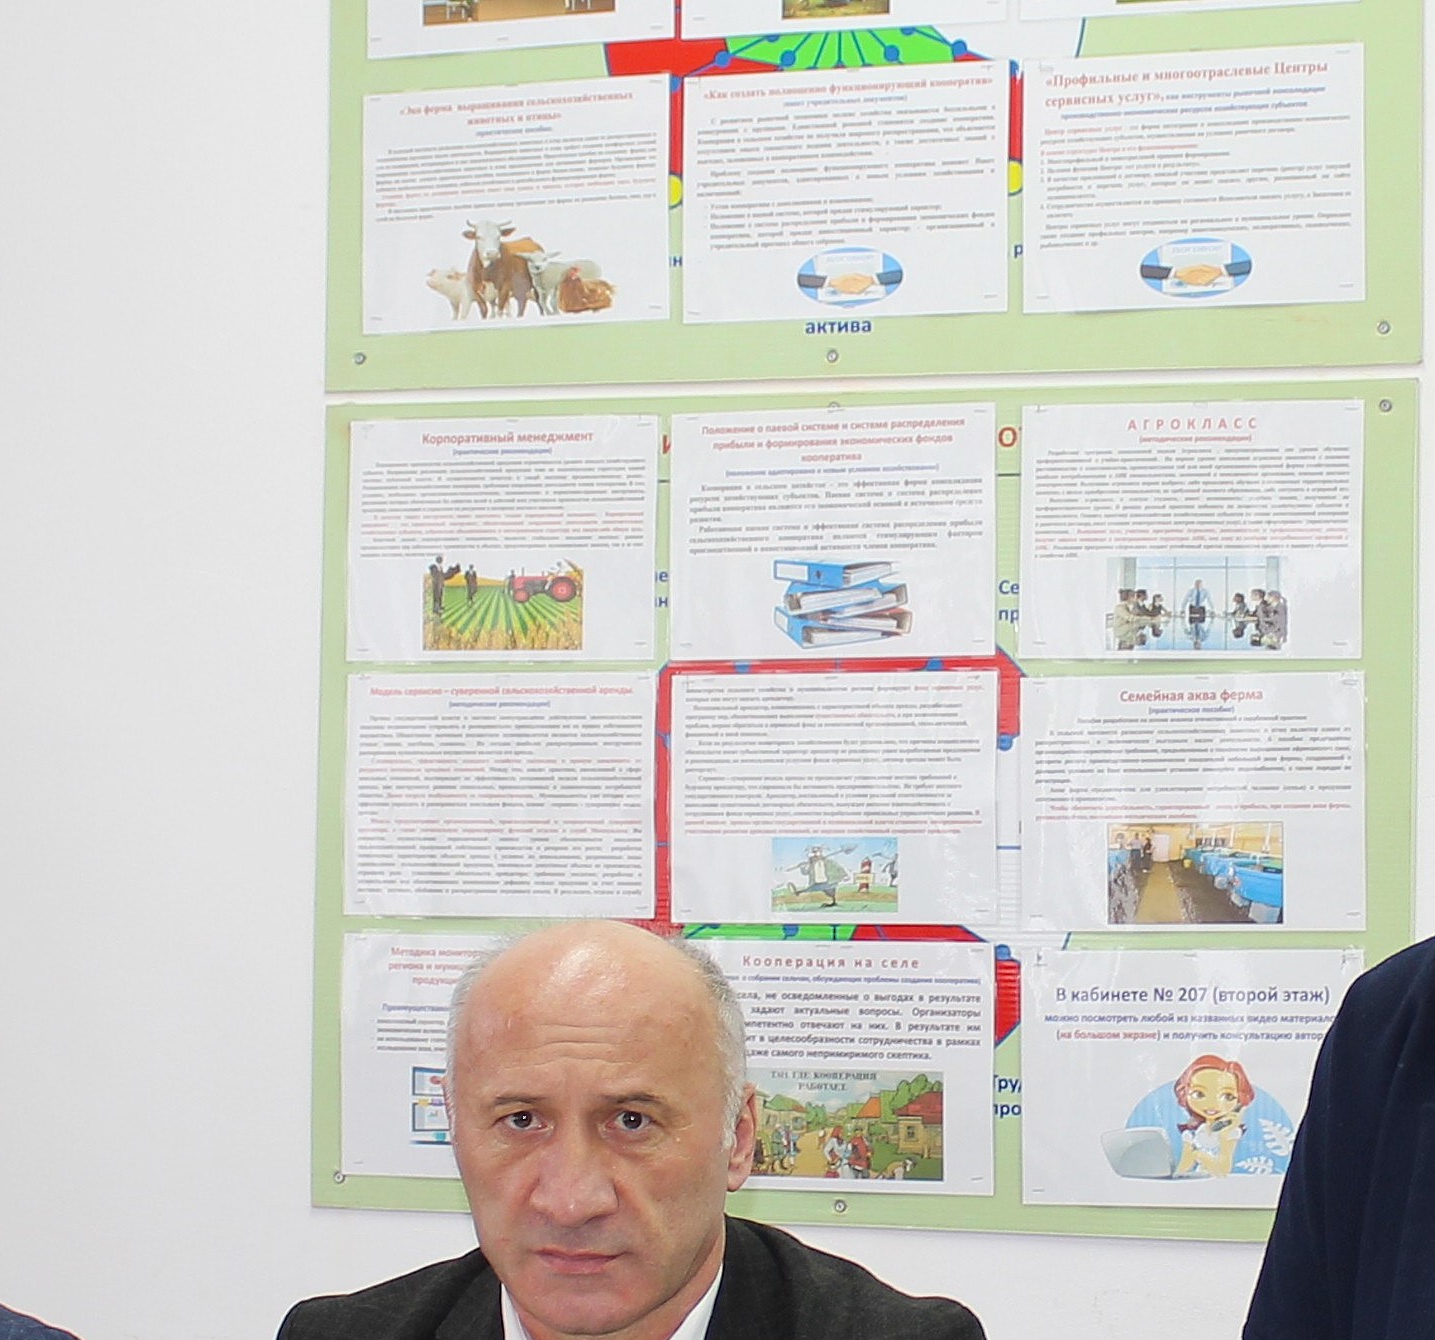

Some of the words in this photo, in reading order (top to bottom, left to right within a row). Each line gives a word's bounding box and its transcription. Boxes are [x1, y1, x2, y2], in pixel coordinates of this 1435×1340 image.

[1046, 71, 1138, 88] «Профильные
[1155, 64, 1270, 82] многоотраслевые
[1274, 61, 1328, 75] Центры
[1045, 94, 1113, 108] сервисных
[805, 320, 871, 334] актива
[702, 425, 755, 436] Положение
[766, 422, 798, 432] паевой
[801, 421, 839, 431] системе
[850, 420, 888, 429] системе
[891, 418, 965, 430] распределения
[422, 432, 514, 445] Корпоративный
[517, 431, 593, 443] менеджмент
[801, 453, 862, 462] кооператива
[1120, 690, 1183, 702] Семейная
[1187, 692, 1216, 700] аква
[1220, 689, 1263, 703] ферма
[743, 955, 845, 969] Кооперация
[854, 958, 872, 968] на
[881, 959, 919, 968] селе
[781, 993, 858, 1001] осведомленные
[875, 994, 914, 1002] выгодах
[929, 995, 980, 1004] результате
[1072, 988, 1148, 1001] кабинете
[1154, 989, 1173, 1000] №
[1179, 989, 1206, 1001] 207
[1214, 987, 1277, 1005] (второй
[1284, 987, 1330, 1004] этаж)
[751, 1007, 784, 1015] задают
[794, 1007, 849, 1016] актуальные
[859, 1007, 902, 1017] вопросы.
[912, 1008, 980, 1018] Организаторы
[1044, 1014, 1079, 1022] можно
[1082, 1014, 1138, 1024] посмотреть
[1141, 1013, 1174, 1022] любой
[1246, 1015, 1277, 1023] видео
[1280, 1015, 1334, 1024] материало
[745, 1021, 793, 1029] мпетентно
[908, 1023, 960, 1032] результате
[768, 1033, 854, 1044] целесообразности
[858, 1037, 933, 1046] сотрудничества
[946, 1039, 980, 1047] рамках
[1056, 1030, 1072, 1040] (на
[1074, 1030, 1120, 1039] большом
[1123, 1031, 1160, 1040] экране)
[1172, 1032, 1218, 1040] получить
[1220, 1032, 1292, 1041] консультацию
[1295, 1032, 1324, 1041] автор
[807, 1051, 884, 1060] непримиримого
[887, 1052, 932, 1060] скептика.
